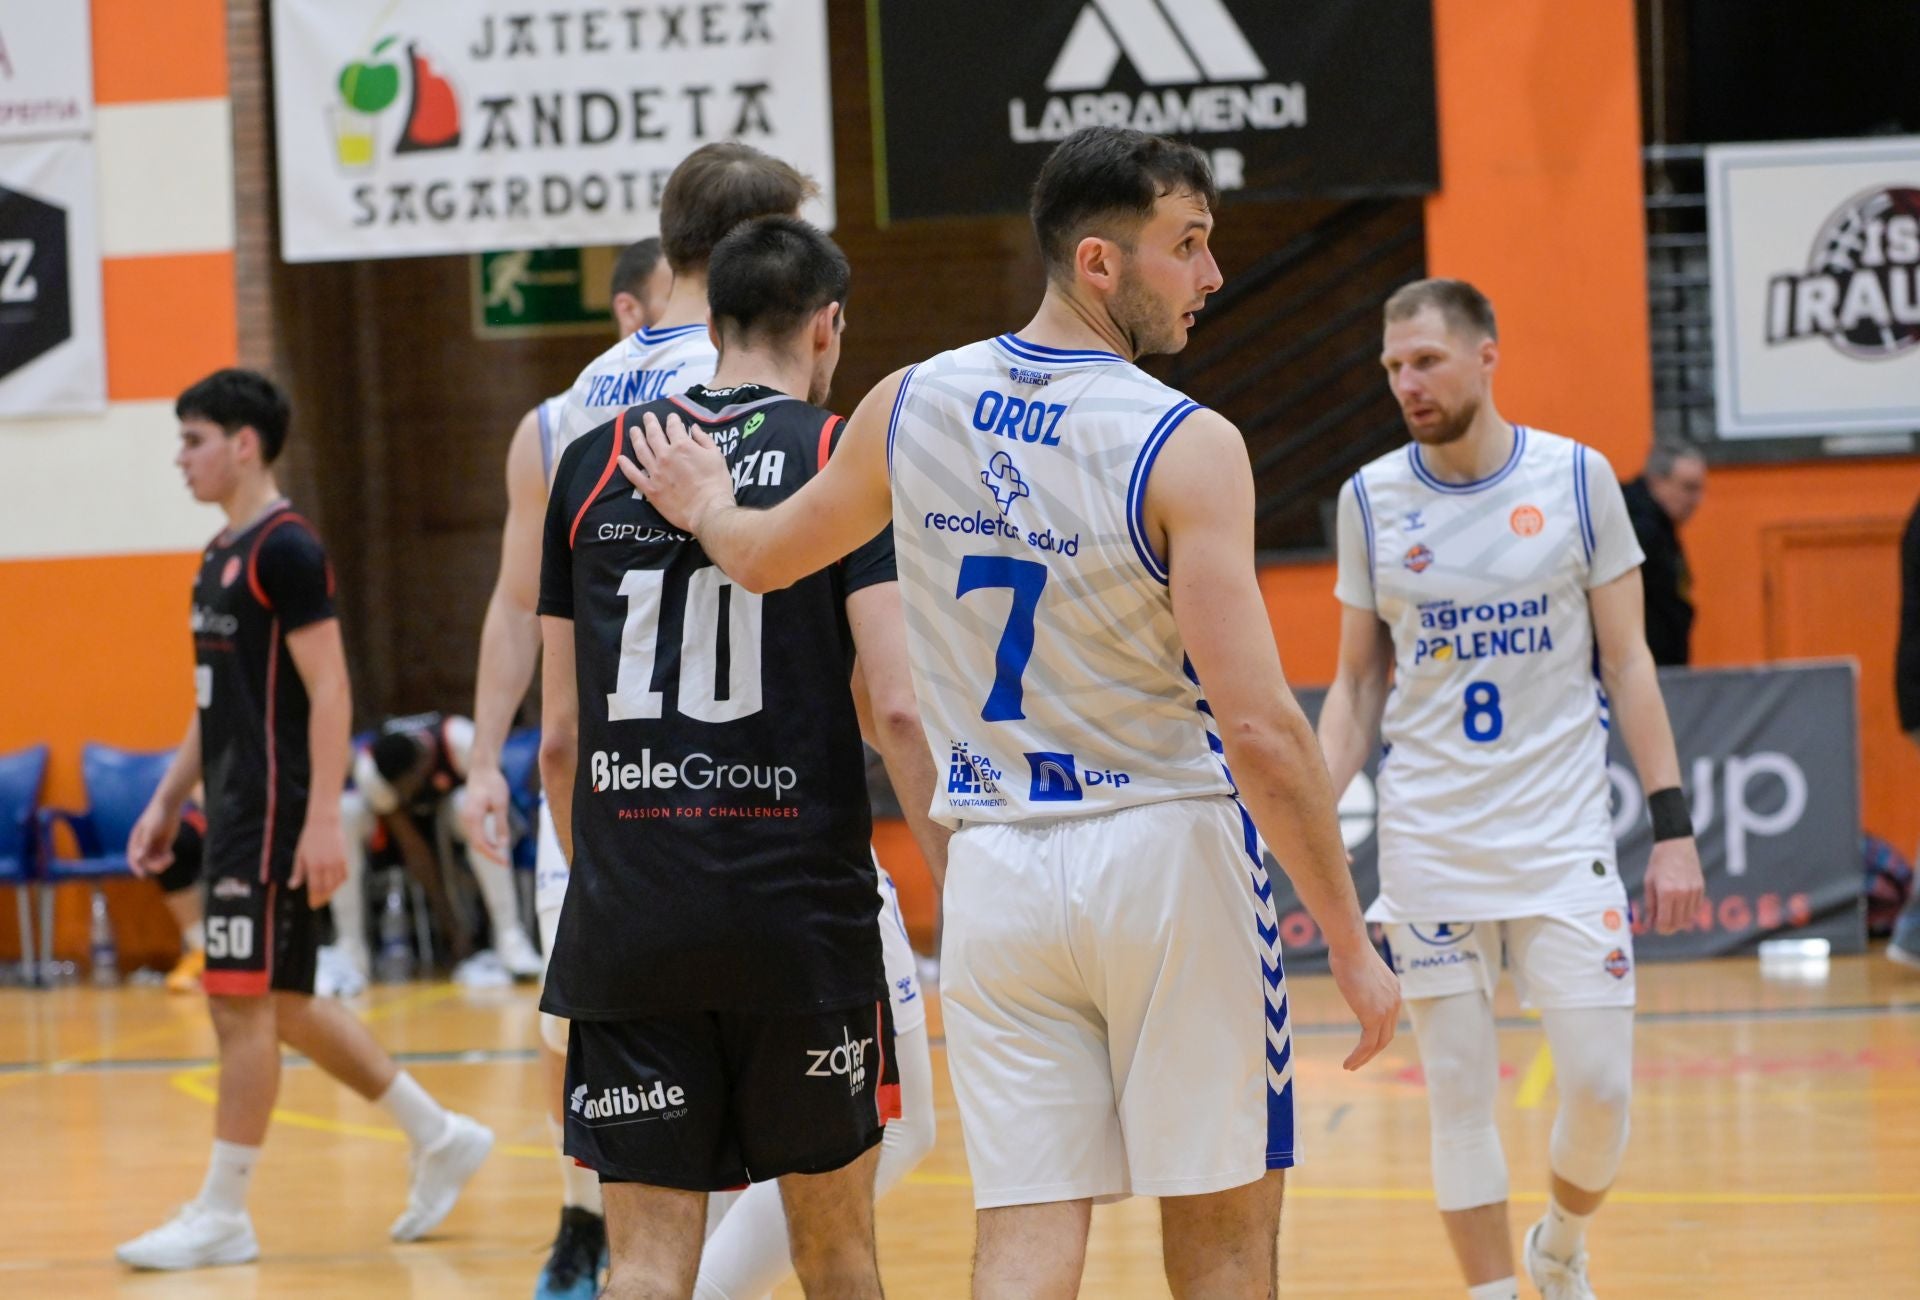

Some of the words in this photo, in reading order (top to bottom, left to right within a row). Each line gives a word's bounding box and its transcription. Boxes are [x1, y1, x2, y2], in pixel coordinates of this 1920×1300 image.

[470, 3, 776, 60] JATETXEA
[480, 83, 776, 151] ANDETA
[353, 172, 667, 226] SAGARDOTE
[973, 390, 1066, 447] OROZ
[598, 523, 697, 542] GIPUZ
[956, 555, 1048, 722] 7
[1421, 594, 1548, 630] agropal
[606, 565, 763, 724] 10
[1463, 681, 1503, 743] 8
[982, 770, 1002, 781] EN
[1085, 769, 1131, 788] Dip
[618, 808, 671, 819] PASSION
[676, 807, 703, 817] FOR
[709, 807, 800, 818] CHALLENGES
[207, 914, 254, 960] 50
